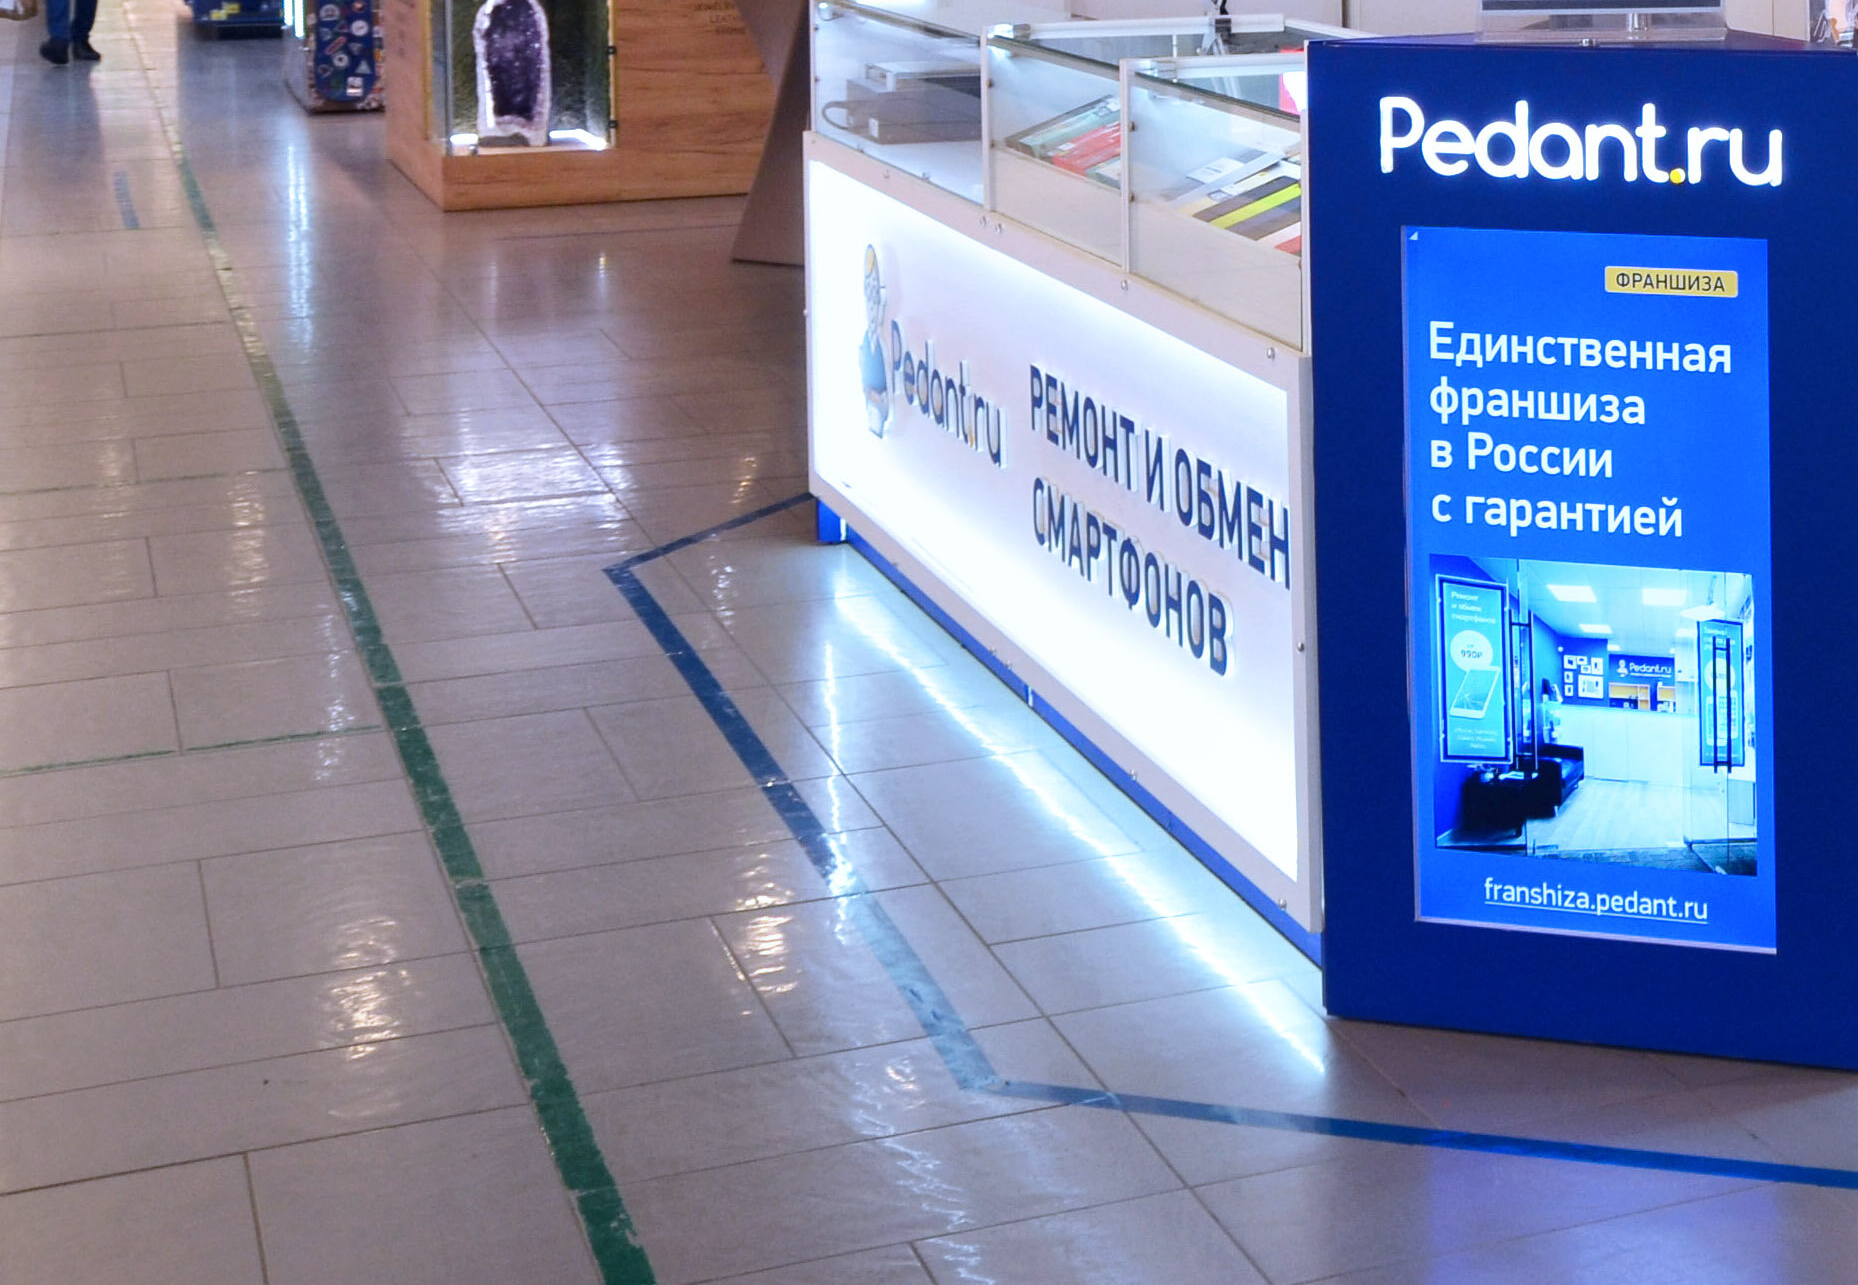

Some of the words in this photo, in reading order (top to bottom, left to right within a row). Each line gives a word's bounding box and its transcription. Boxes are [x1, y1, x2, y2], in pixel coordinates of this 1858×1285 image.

[1379, 96, 1783, 187] Pedant.ru
[1616, 272, 1725, 292] ФРАНШИЗА
[1429, 320, 1732, 374] Единственная
[891, 319, 1002, 465] Pedant.ru
[1429, 376, 1645, 425] франшиза
[1030, 364, 1136, 492] РЕМОНТ
[1145, 430, 1165, 512] И
[1174, 448, 1291, 590] ОБМЕН
[1430, 439, 1453, 468] в
[1467, 432, 1613, 478] России
[1432, 492, 1452, 523] с
[1465, 496, 1683, 537] гарантией
[1032, 476, 1229, 676] СМАРТФОНОВ
[1629, 662, 1671, 673] Pedant.ru
[1484, 877, 1708, 921] franshiza.pedant.ru
